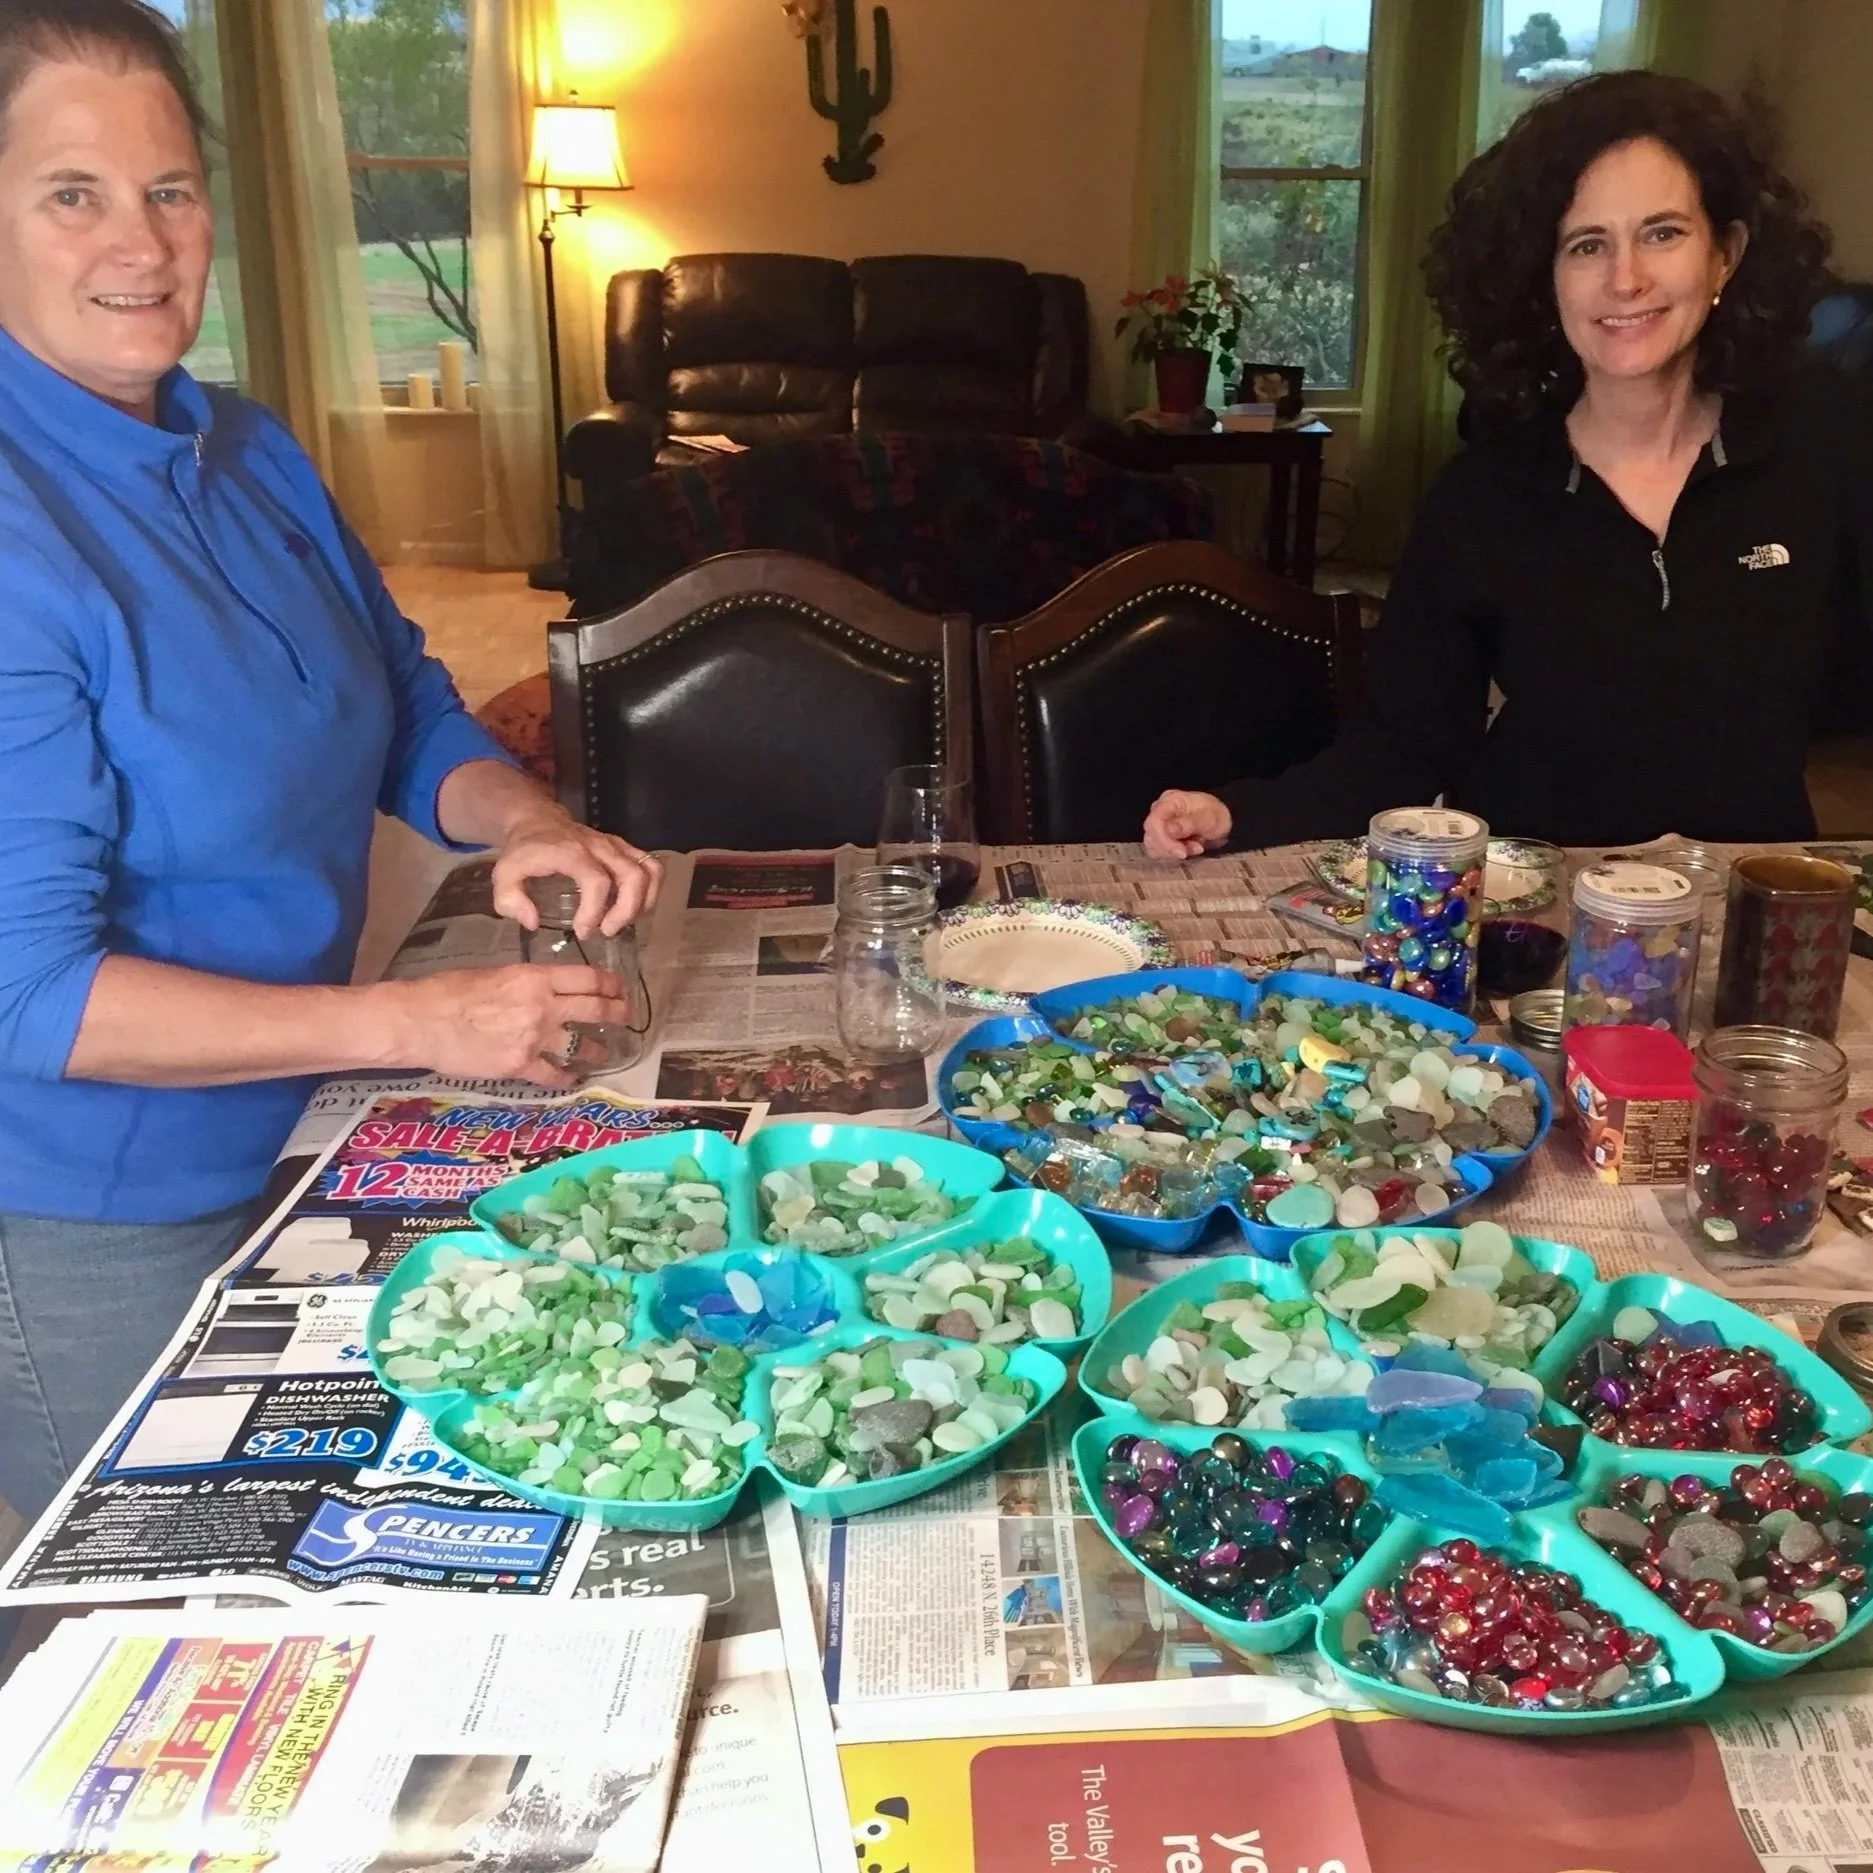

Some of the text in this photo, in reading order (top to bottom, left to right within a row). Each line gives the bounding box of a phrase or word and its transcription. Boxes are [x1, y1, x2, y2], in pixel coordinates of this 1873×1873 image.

[1738, 551, 1774, 565] NORTH
[1752, 544, 1772, 555] THE
[1748, 560, 1774, 571] FACE
[434, 1106, 538, 1130] NEW
[326, 1161, 409, 1199] 12
[408, 1176, 499, 1187] SAME AS
[412, 1164, 507, 1178] MONTHS
[402, 1187, 461, 1198] CASH
[402, 1216, 483, 1230] Whirlpoo
[265, 1394, 390, 1404] DISHWASHER
[279, 1378, 380, 1392] Hotpoin
[243, 1427, 378, 1458] $219
[384, 1450, 492, 1484] $94
[84, 1477, 544, 1510] Arizona's largest independent dea
[343, 1503, 536, 1560] SPENCERS
[621, 1526, 706, 1567] real
[79, 1573, 144, 1585] SAMSUNG
[286, 1558, 445, 1582] www.spencerstv.com
[339, 1575, 386, 1587] MAYTAG
[539, 1555, 564, 1594] AMANA
[402, 1581, 472, 1592] KitchenAid
[829, 1581, 840, 1648] OPEN TODAY 1-4PM
[980, 1553, 1001, 1657] 14248 N. 26th Place
[295, 1640, 321, 1685] CARPET
[292, 1687, 321, 1724] WITH
[110, 1715, 135, 1738] WILL
[273, 1727, 303, 1762] NEW
[252, 1673, 348, 1858] RING IN THE NEW YEAR
[240, 1763, 284, 1831] FLOORS
[1081, 1764, 1107, 1801] The
[1047, 1821, 1077, 1867] tool.
